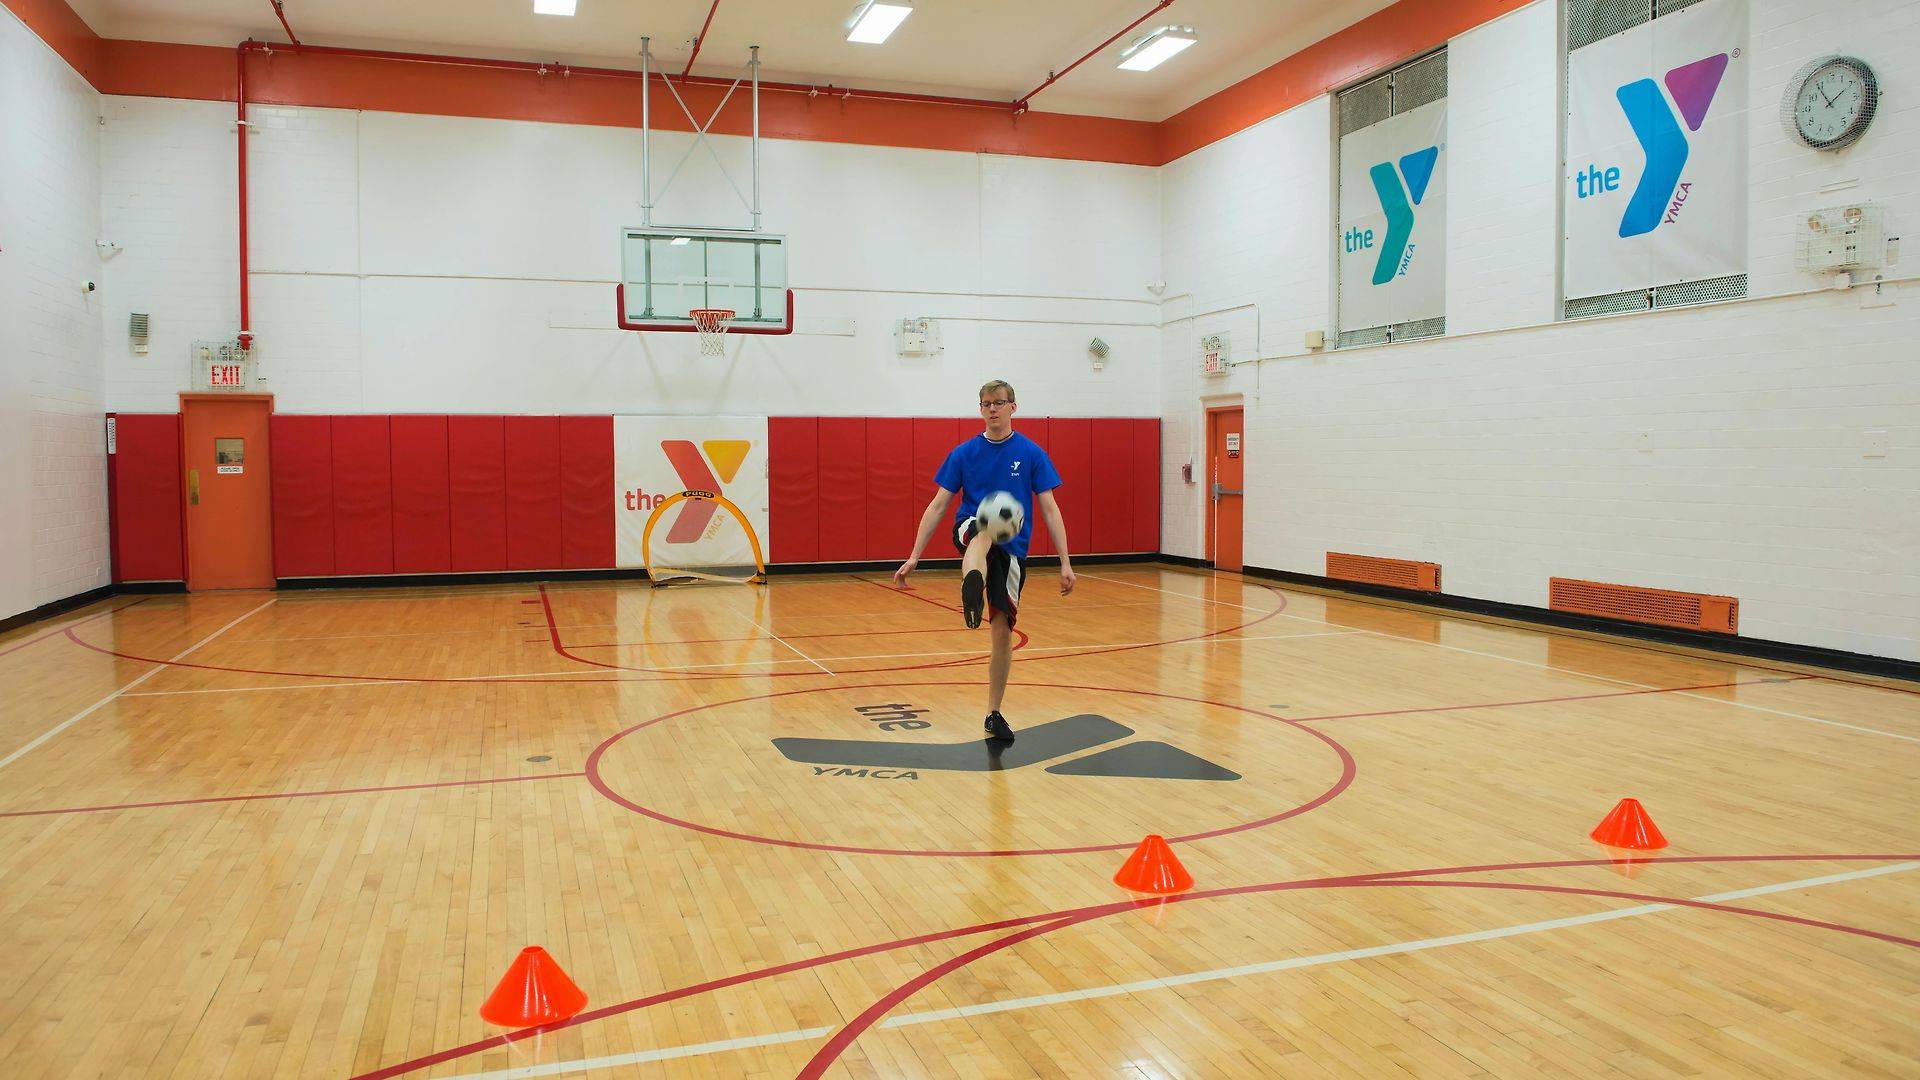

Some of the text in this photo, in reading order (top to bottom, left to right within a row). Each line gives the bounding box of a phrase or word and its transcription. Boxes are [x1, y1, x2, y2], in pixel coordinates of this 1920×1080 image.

[1576, 164, 1620, 198] the
[1664, 182, 1692, 224] YMCA
[1345, 226, 1373, 253] the
[1399, 243, 1415, 277] YMCA
[211, 365, 241, 385] EXIT
[624, 488, 667, 511] the
[703, 514, 726, 541] YMCA
[853, 703, 932, 731] the
[813, 766, 918, 781] YMCA
